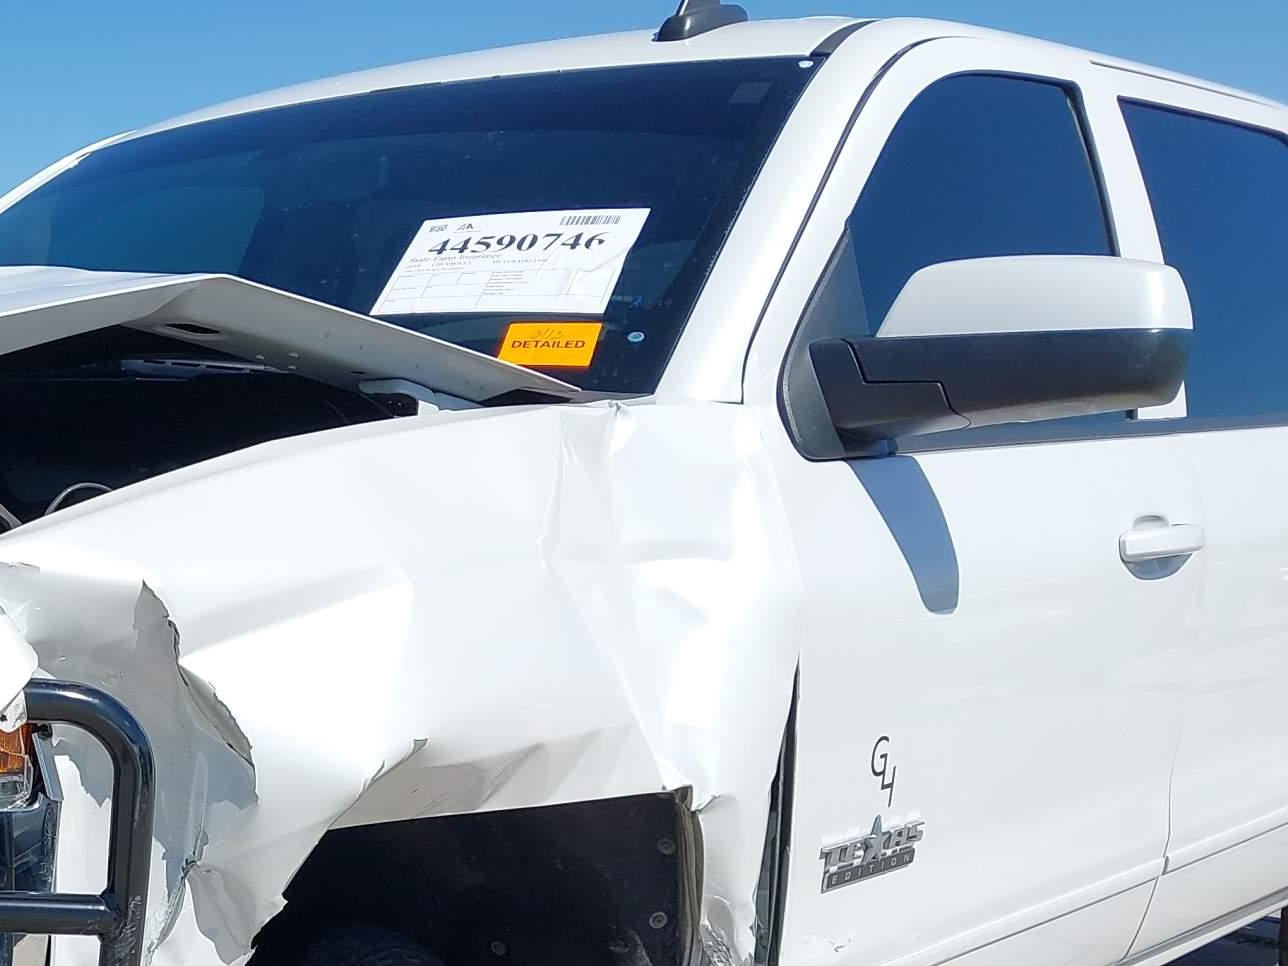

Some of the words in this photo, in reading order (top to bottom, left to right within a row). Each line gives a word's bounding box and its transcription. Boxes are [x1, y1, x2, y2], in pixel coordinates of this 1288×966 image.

[428, 231, 611, 254] 44590746
[511, 340, 586, 349] DETAILED
[819, 821, 926, 869] TEXAS
[831, 853, 912, 886] EDITION
